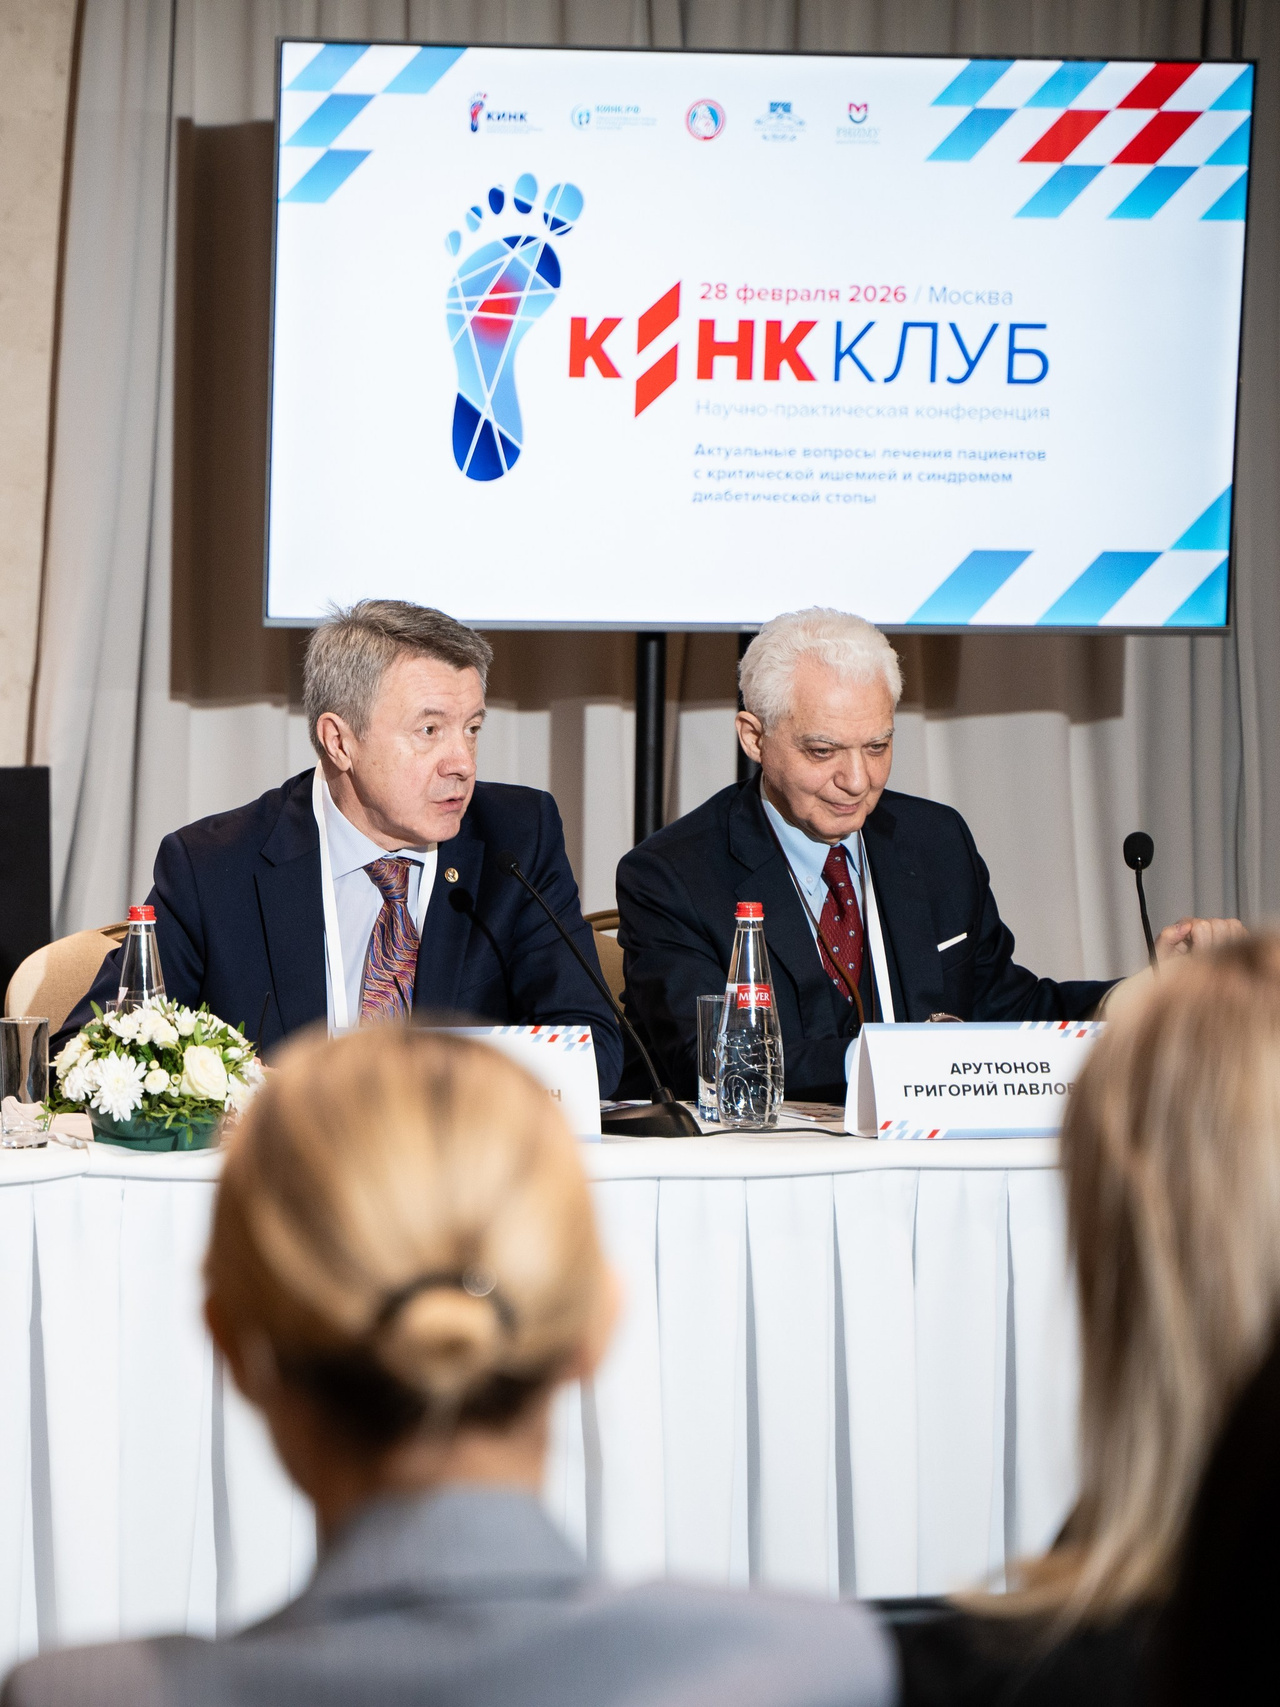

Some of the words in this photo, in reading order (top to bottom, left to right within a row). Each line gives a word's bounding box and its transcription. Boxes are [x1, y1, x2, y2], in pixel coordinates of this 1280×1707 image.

[700, 283, 727, 300] 28
[736, 284, 840, 305] февраля
[849, 285, 906, 303] 2026
[929, 285, 1013, 305] Москва
[834, 321, 1049, 384] КЛУБ
[696, 400, 909, 420] Научно-практическая
[915, 404, 1050, 422] конференция
[694, 443, 797, 460] Актуальные
[802, 448, 876, 461] вопросы
[882, 449, 952, 459] лечения
[958, 450, 1046, 461] пациентов
[693, 469, 700, 479] с
[707, 468, 814, 481] критической
[820, 469, 897, 481] ишемией
[902, 472, 912, 480] и
[917, 472, 1012, 485] синдромом
[692, 490, 820, 503] диабетической
[825, 493, 876, 504] стопы
[951, 1062, 1050, 1074] АРУТЮНОВ
[904, 1081, 998, 1097] ГРИГОРИЙ
